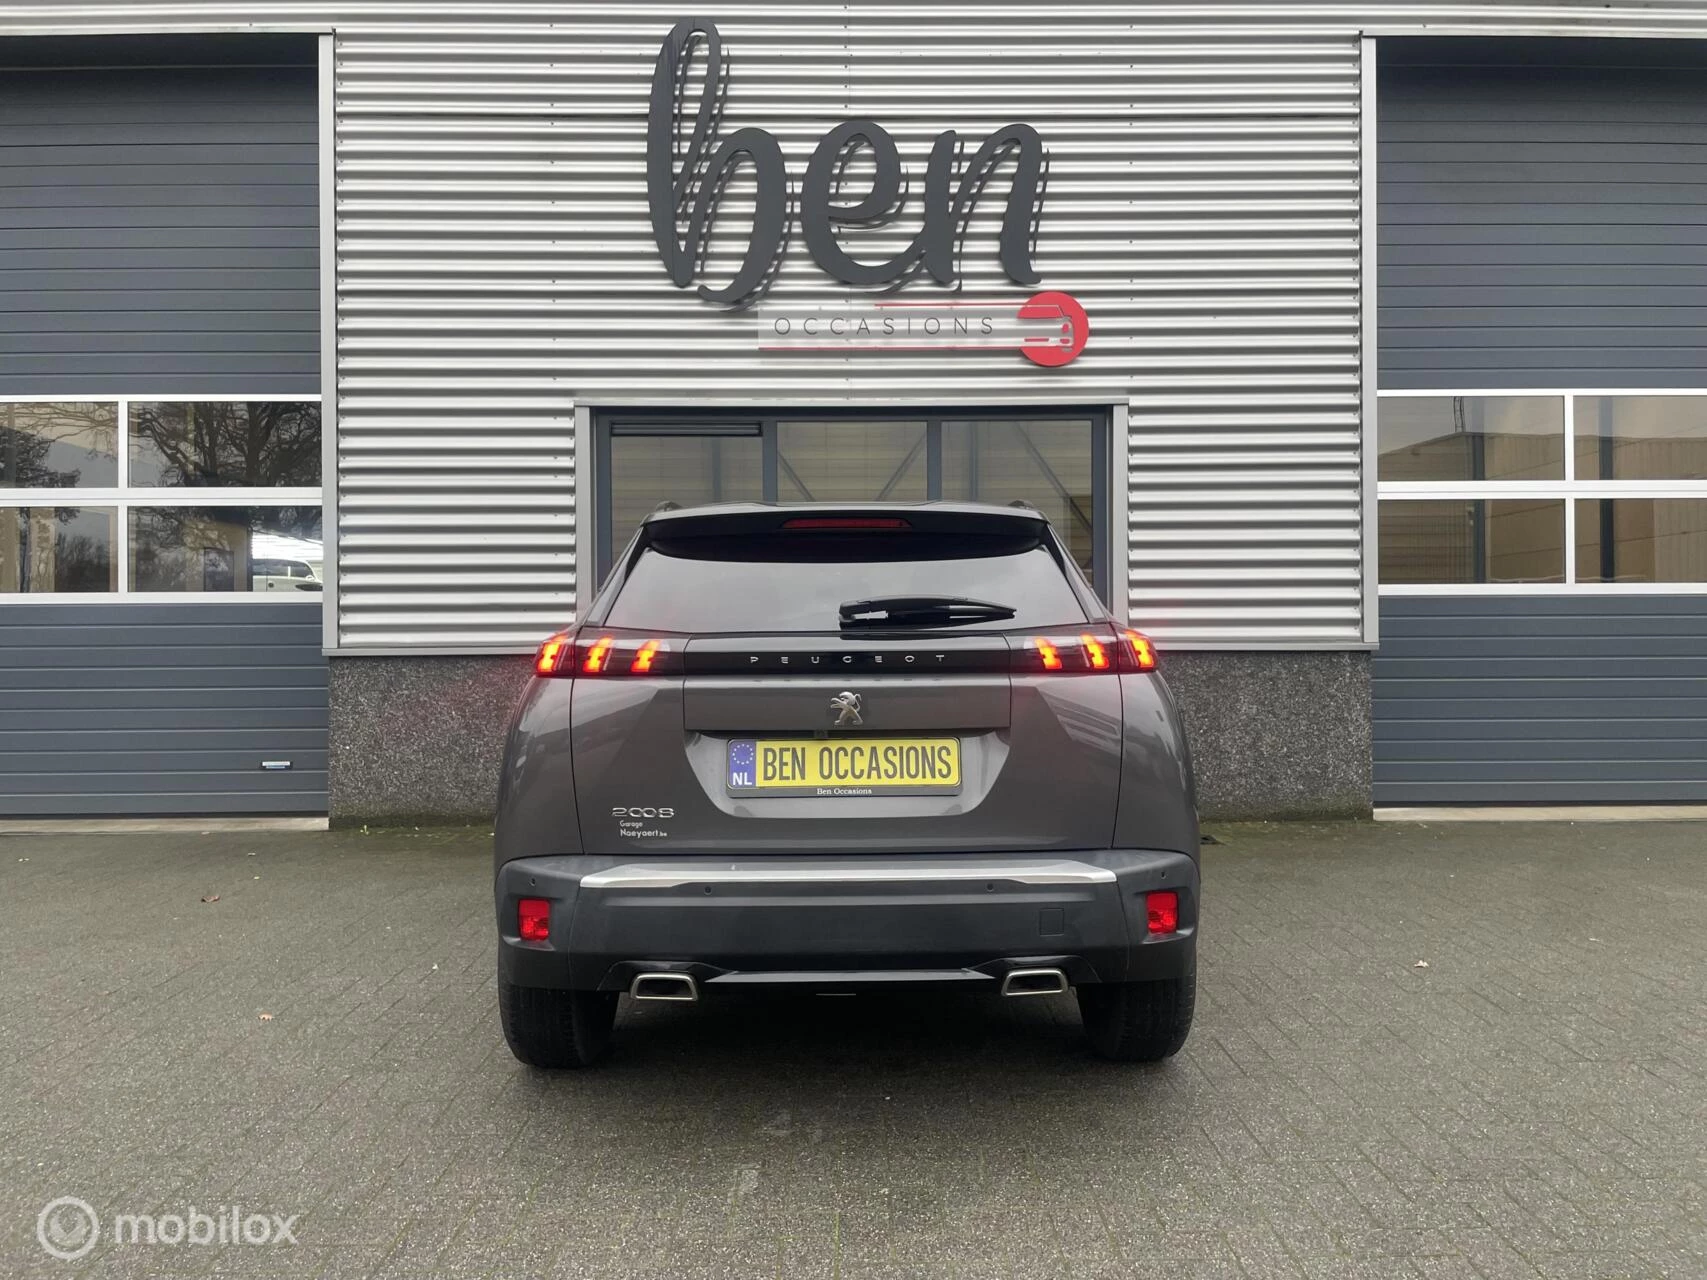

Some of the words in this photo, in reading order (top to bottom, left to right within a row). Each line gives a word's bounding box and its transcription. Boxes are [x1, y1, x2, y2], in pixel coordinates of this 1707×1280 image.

[646, 16, 1042, 301] ben
[773, 316, 994, 336] OCCASIONS
[750, 654, 945, 664] PEUGEOT
[763, 747, 806, 781] BEN
[819, 745, 951, 780] OCCASIONS
[732, 772, 752, 786] NL
[816, 787, 832, 795] Ben
[833, 787, 873, 796] Occasions
[611, 807, 675, 818] 2008
[620, 820, 643, 828] Garage
